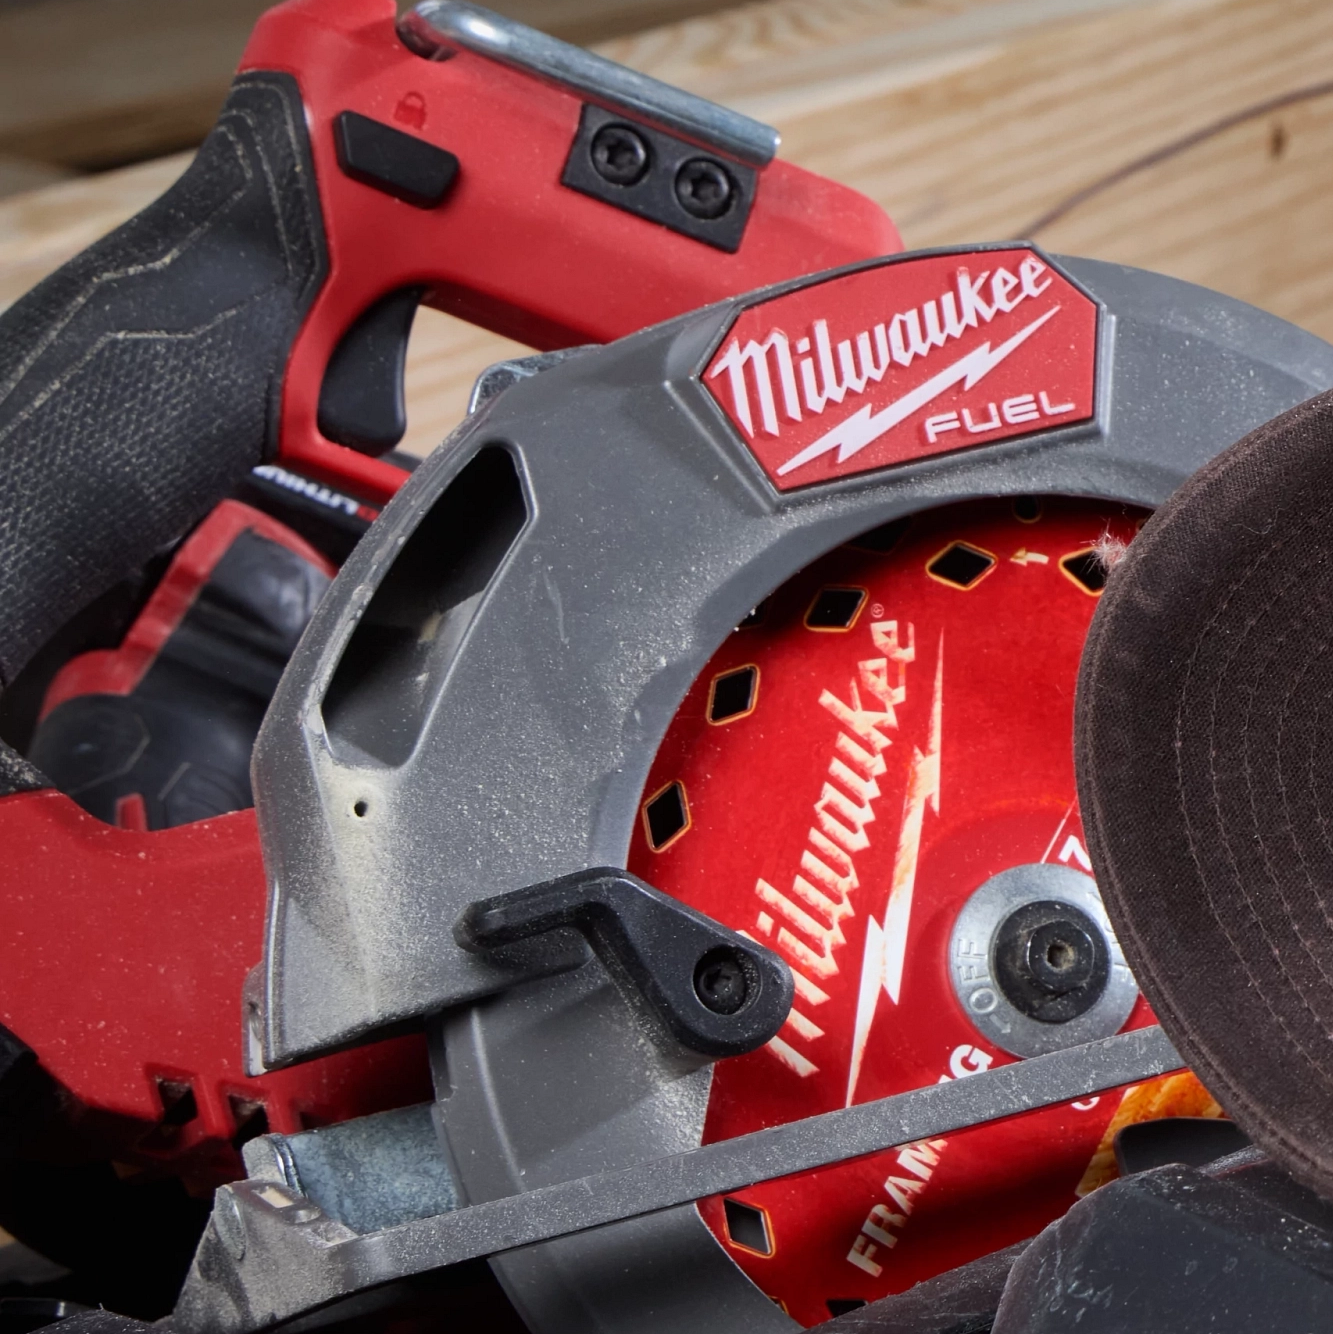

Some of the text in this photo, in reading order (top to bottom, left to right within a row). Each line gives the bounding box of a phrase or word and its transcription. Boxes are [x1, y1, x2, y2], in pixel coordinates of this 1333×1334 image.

[710, 255, 1052, 439] Milwaukee
[924, 391, 1075, 444] FUEL
[846, 1044, 994, 1278] FRAMG
